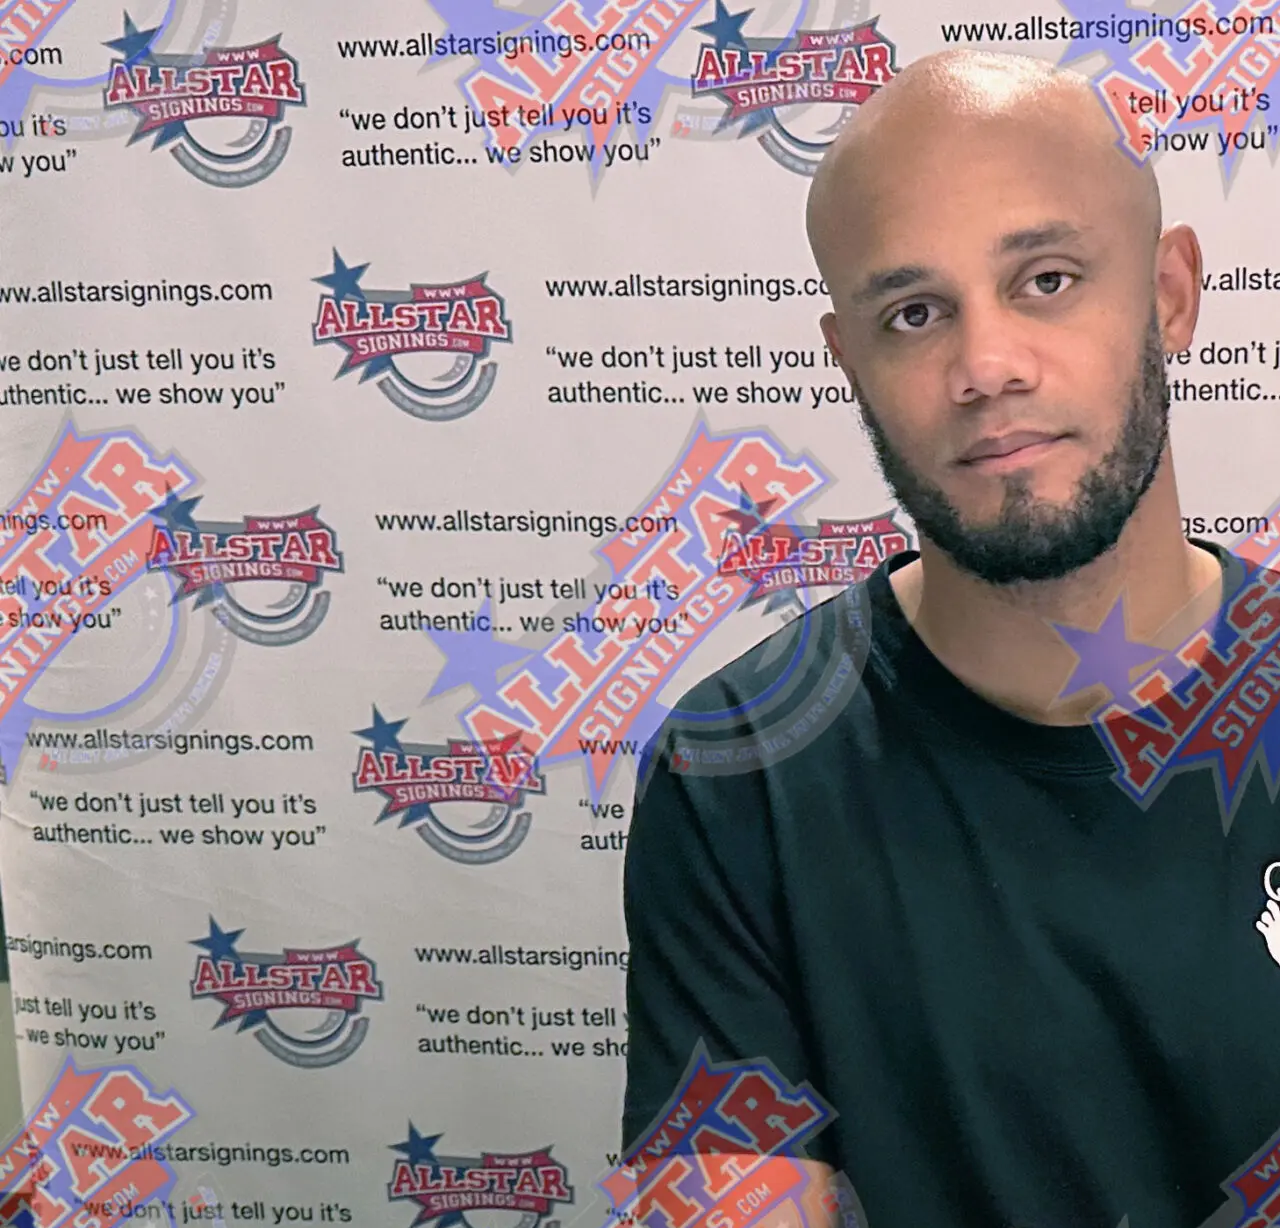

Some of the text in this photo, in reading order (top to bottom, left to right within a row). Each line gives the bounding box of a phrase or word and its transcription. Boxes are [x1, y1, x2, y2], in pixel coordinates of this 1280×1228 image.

[940, 12, 1278, 45] www.allstarsignings.com
[336, 29, 652, 60] www.allstarsignings.com
[107, 60, 302, 103] ALLSTAR
[463, 103, 511, 135] just
[517, 102, 555, 128] tell
[561, 107, 608, 132] you
[341, 141, 478, 168] authentic...
[484, 145, 523, 165] we
[527, 138, 596, 164] show
[316, 297, 508, 339] ALLSTAR
[374, 509, 679, 539] www.allstarsignings.com
[151, 529, 339, 568] ALLSTAR
[498, 576, 545, 605] just
[548, 577, 587, 600] tell
[593, 583, 638, 605] you
[519, 615, 556, 633] we
[562, 611, 627, 634] show
[25, 728, 314, 756] www.allstarsignings.com
[139, 792, 184, 819] just
[188, 792, 225, 814] tell
[230, 797, 275, 820] you
[31, 822, 153, 845] authentic...
[158, 828, 196, 845] we
[201, 824, 265, 846] show
[192, 957, 381, 997] ALLSTAR
[71, 1142, 350, 1168] www.allstarsignings.com
[390, 1162, 570, 1200] ALLSTAR
